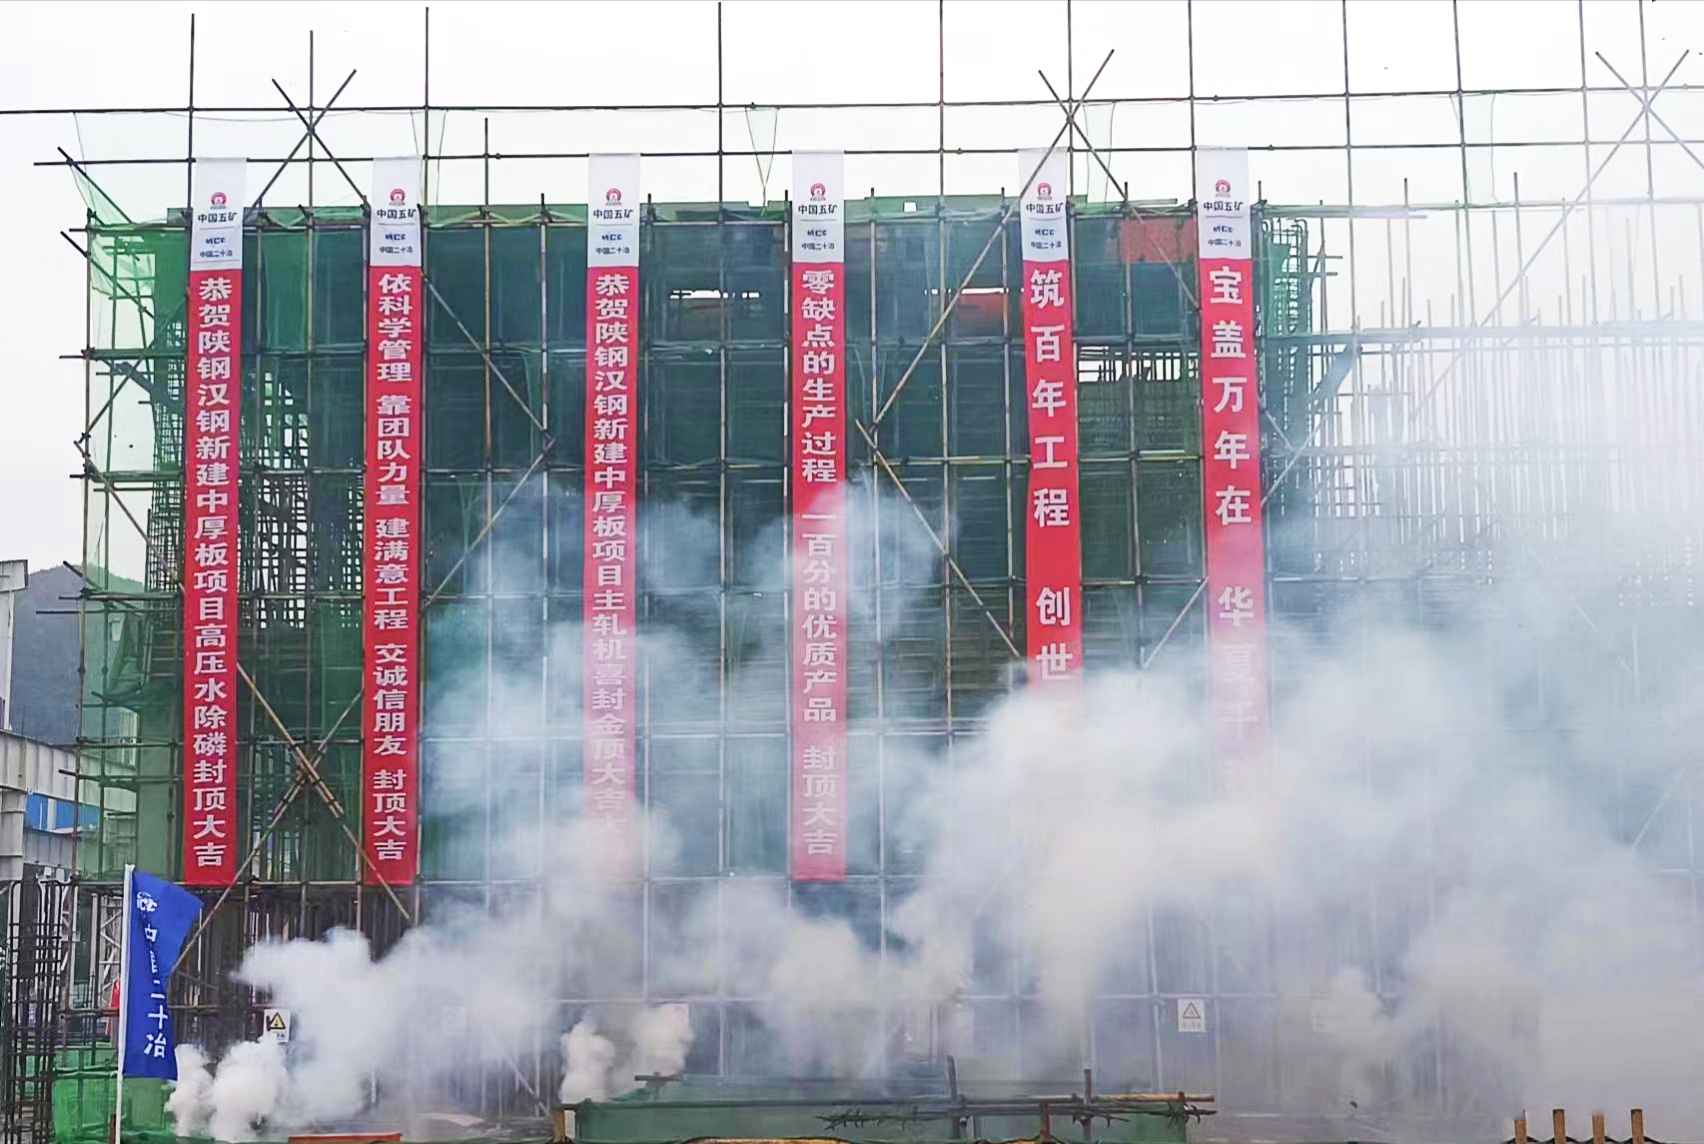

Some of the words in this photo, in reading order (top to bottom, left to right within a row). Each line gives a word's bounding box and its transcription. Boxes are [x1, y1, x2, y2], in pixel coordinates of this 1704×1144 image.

[198, 211, 237, 223] 中国五矿
[376, 208, 417, 220] 中国五矿
[593, 208, 634, 220] 中国五矿
[798, 204, 838, 215] 中国五矿
[1026, 202, 1064, 213] 中国五矿
[1203, 201, 1244, 212] 中国五矿
[377, 273, 412, 383] 依科学管理
[801, 269, 838, 483] 零缺点的生产过程
[375, 393, 412, 505] 靠团队力量
[1030, 269, 1071, 528] 筑百年工程
[1209, 266, 1254, 525] 宝盖万年在
[193, 276, 231, 867] 恭贺陕钢汉钢新建中厚板项目高压水除磷封顶大吉
[373, 517, 411, 630] 建满意工程
[801, 513, 838, 722] 一百分的优质产品
[372, 643, 409, 755] 交诚信朋友
[1218, 586, 1259, 765] 华夏千
[372, 768, 408, 861] 封顶大吉
[802, 744, 838, 855] 封顶大吉
